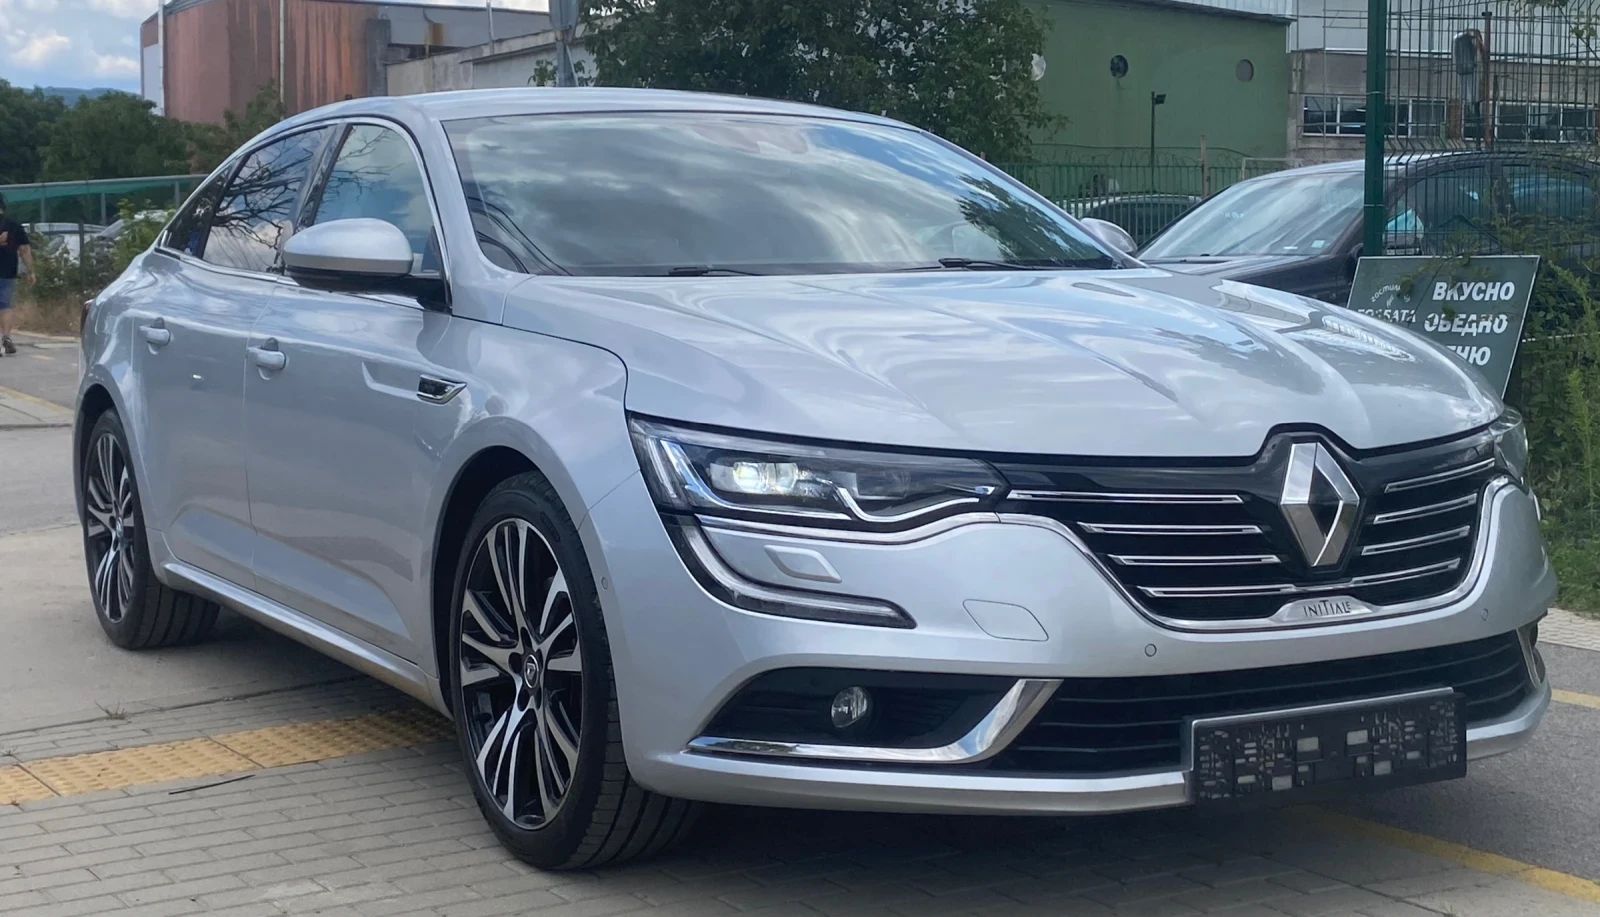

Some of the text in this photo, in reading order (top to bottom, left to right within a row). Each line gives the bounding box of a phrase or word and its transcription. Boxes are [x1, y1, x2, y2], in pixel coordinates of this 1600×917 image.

[1432, 281, 1515, 301] ВКУСНО
[1424, 313, 1508, 337] ОБЕДНО
[1303, 600, 1351, 617] INITIALE
